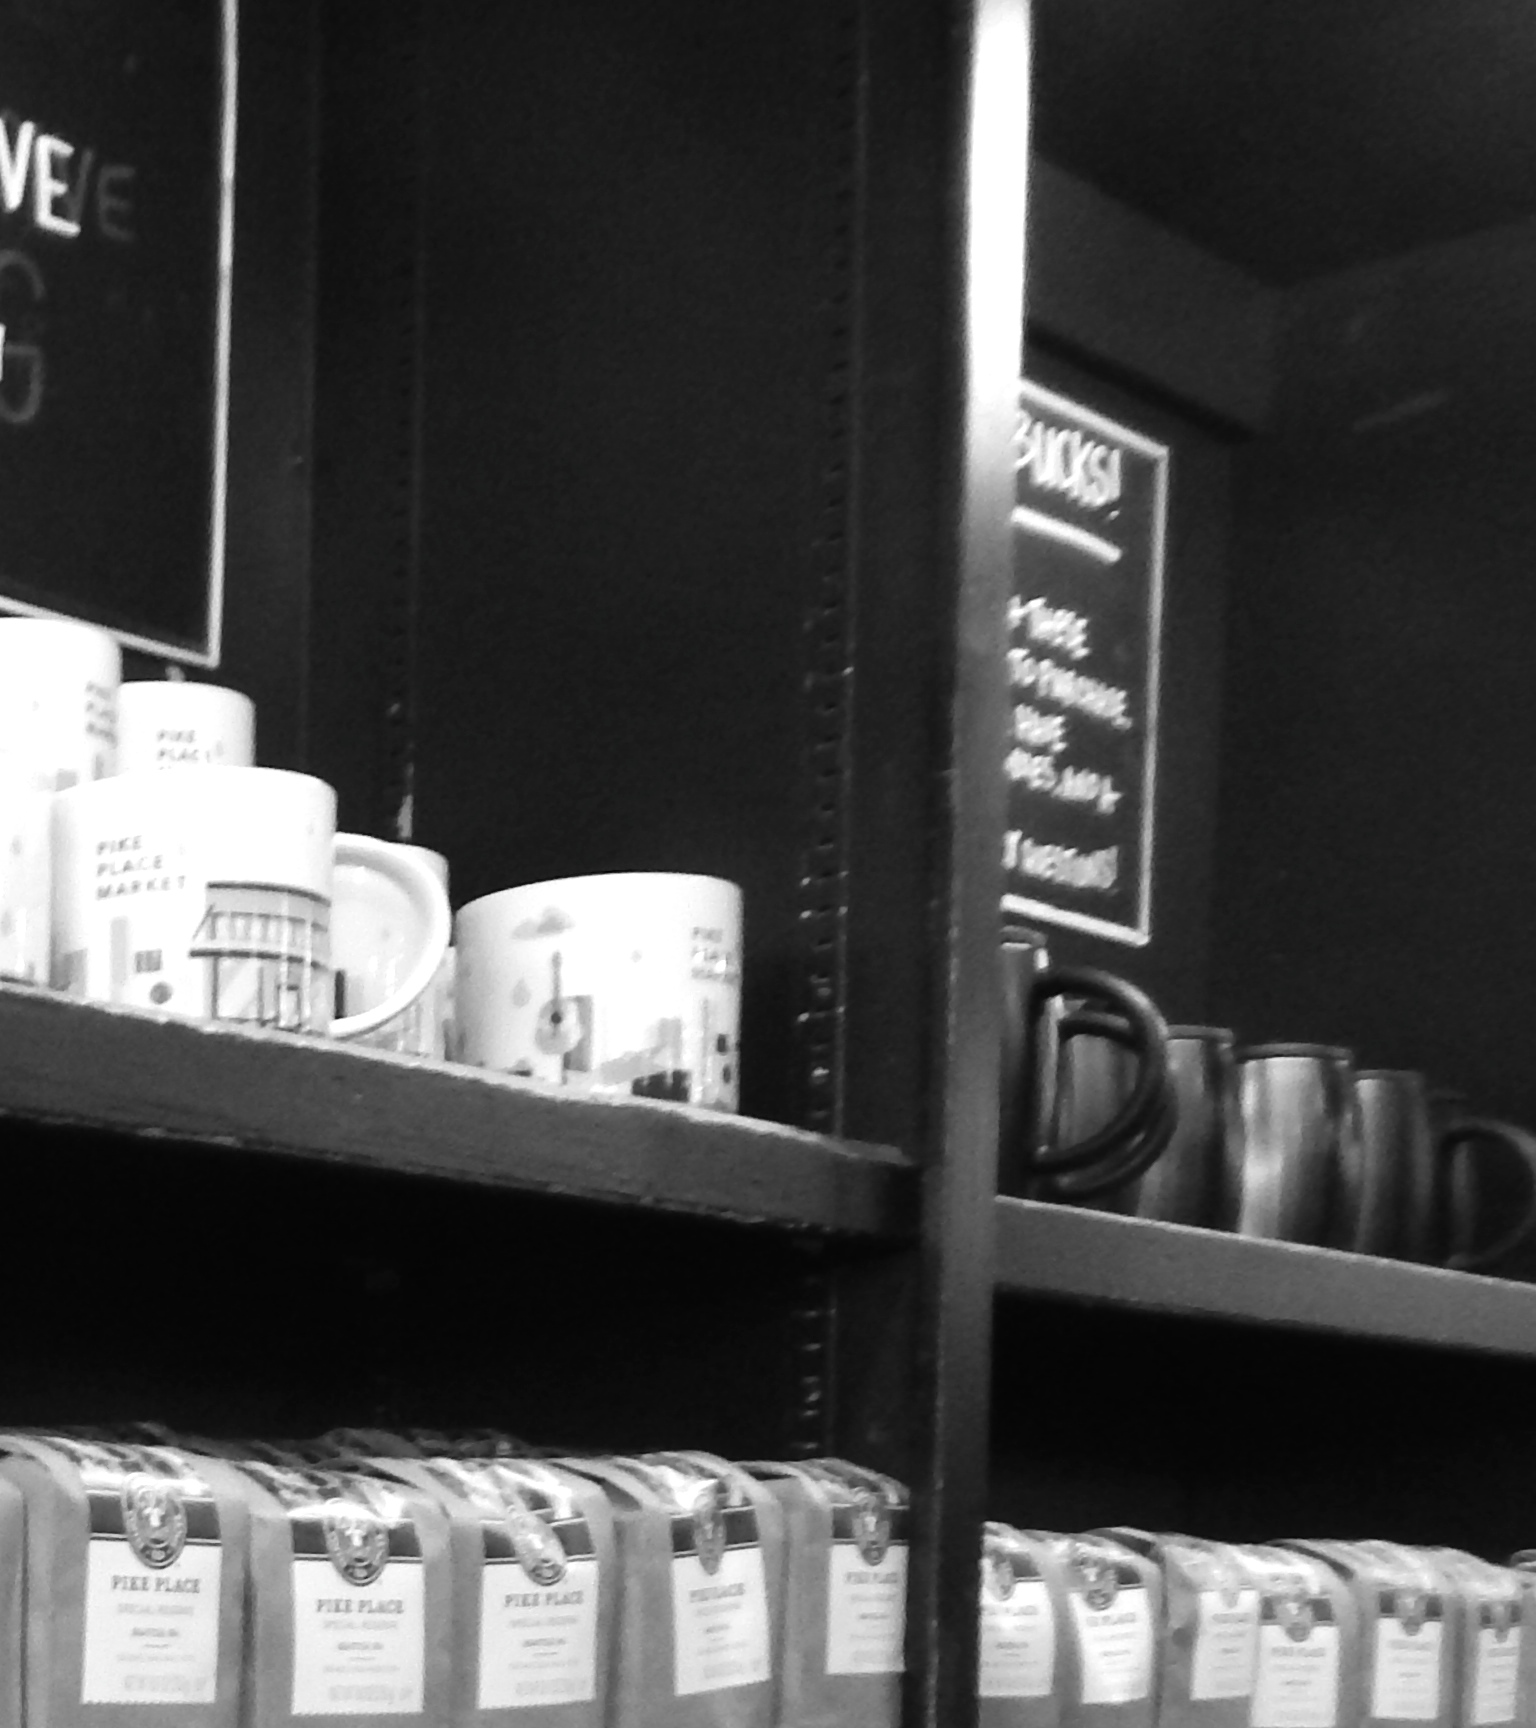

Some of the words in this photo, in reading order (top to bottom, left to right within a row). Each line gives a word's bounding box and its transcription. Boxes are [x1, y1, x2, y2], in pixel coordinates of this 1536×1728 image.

[95, 834, 143, 857] PIKE
[95, 853, 164, 879] PLACE
[94, 874, 187, 902] MARKET
[154, 1576, 201, 1594] PLACE
